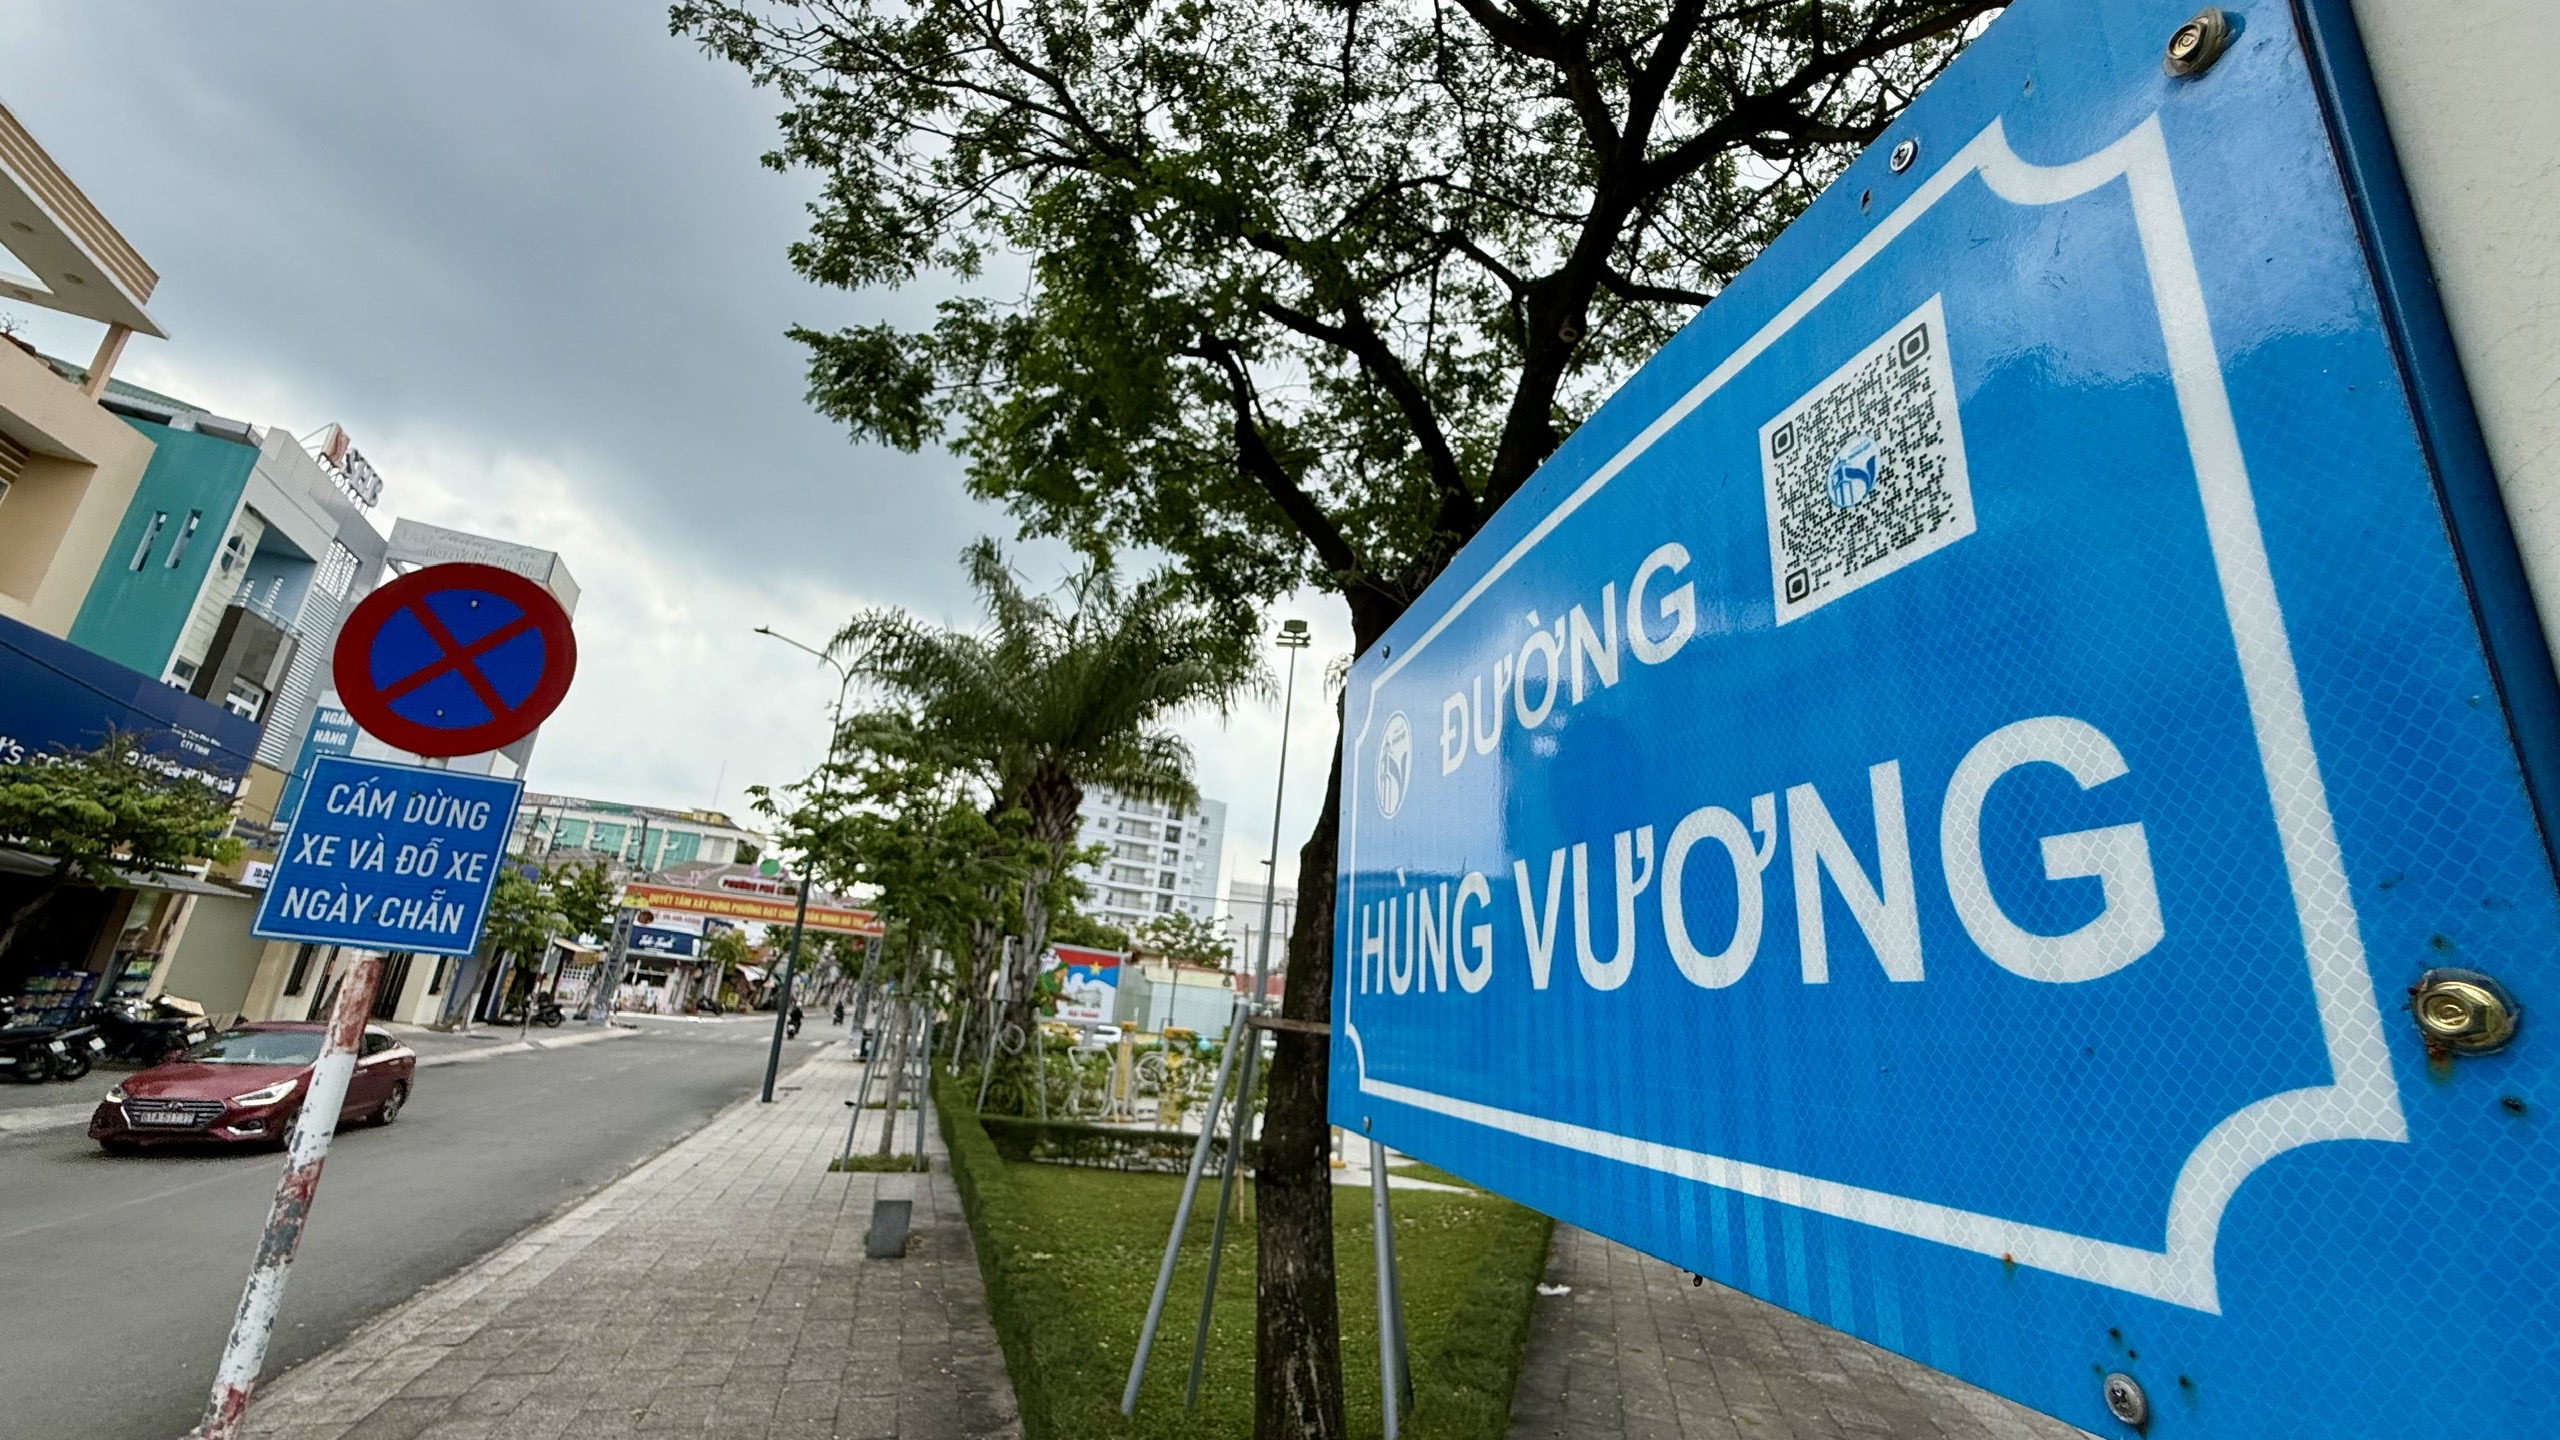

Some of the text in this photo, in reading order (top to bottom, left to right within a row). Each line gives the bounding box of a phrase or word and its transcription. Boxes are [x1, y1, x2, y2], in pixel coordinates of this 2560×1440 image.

[1440, 542, 1697, 777] ĐƯỜNG
[326, 776, 490, 831] CẤM DỪNG
[293, 832, 487, 883] XE VÀ ĐỖ XE
[1361, 715, 2165, 995] HÙNG VƯƠNG
[281, 883, 464, 935] NGÀY CHẴN
